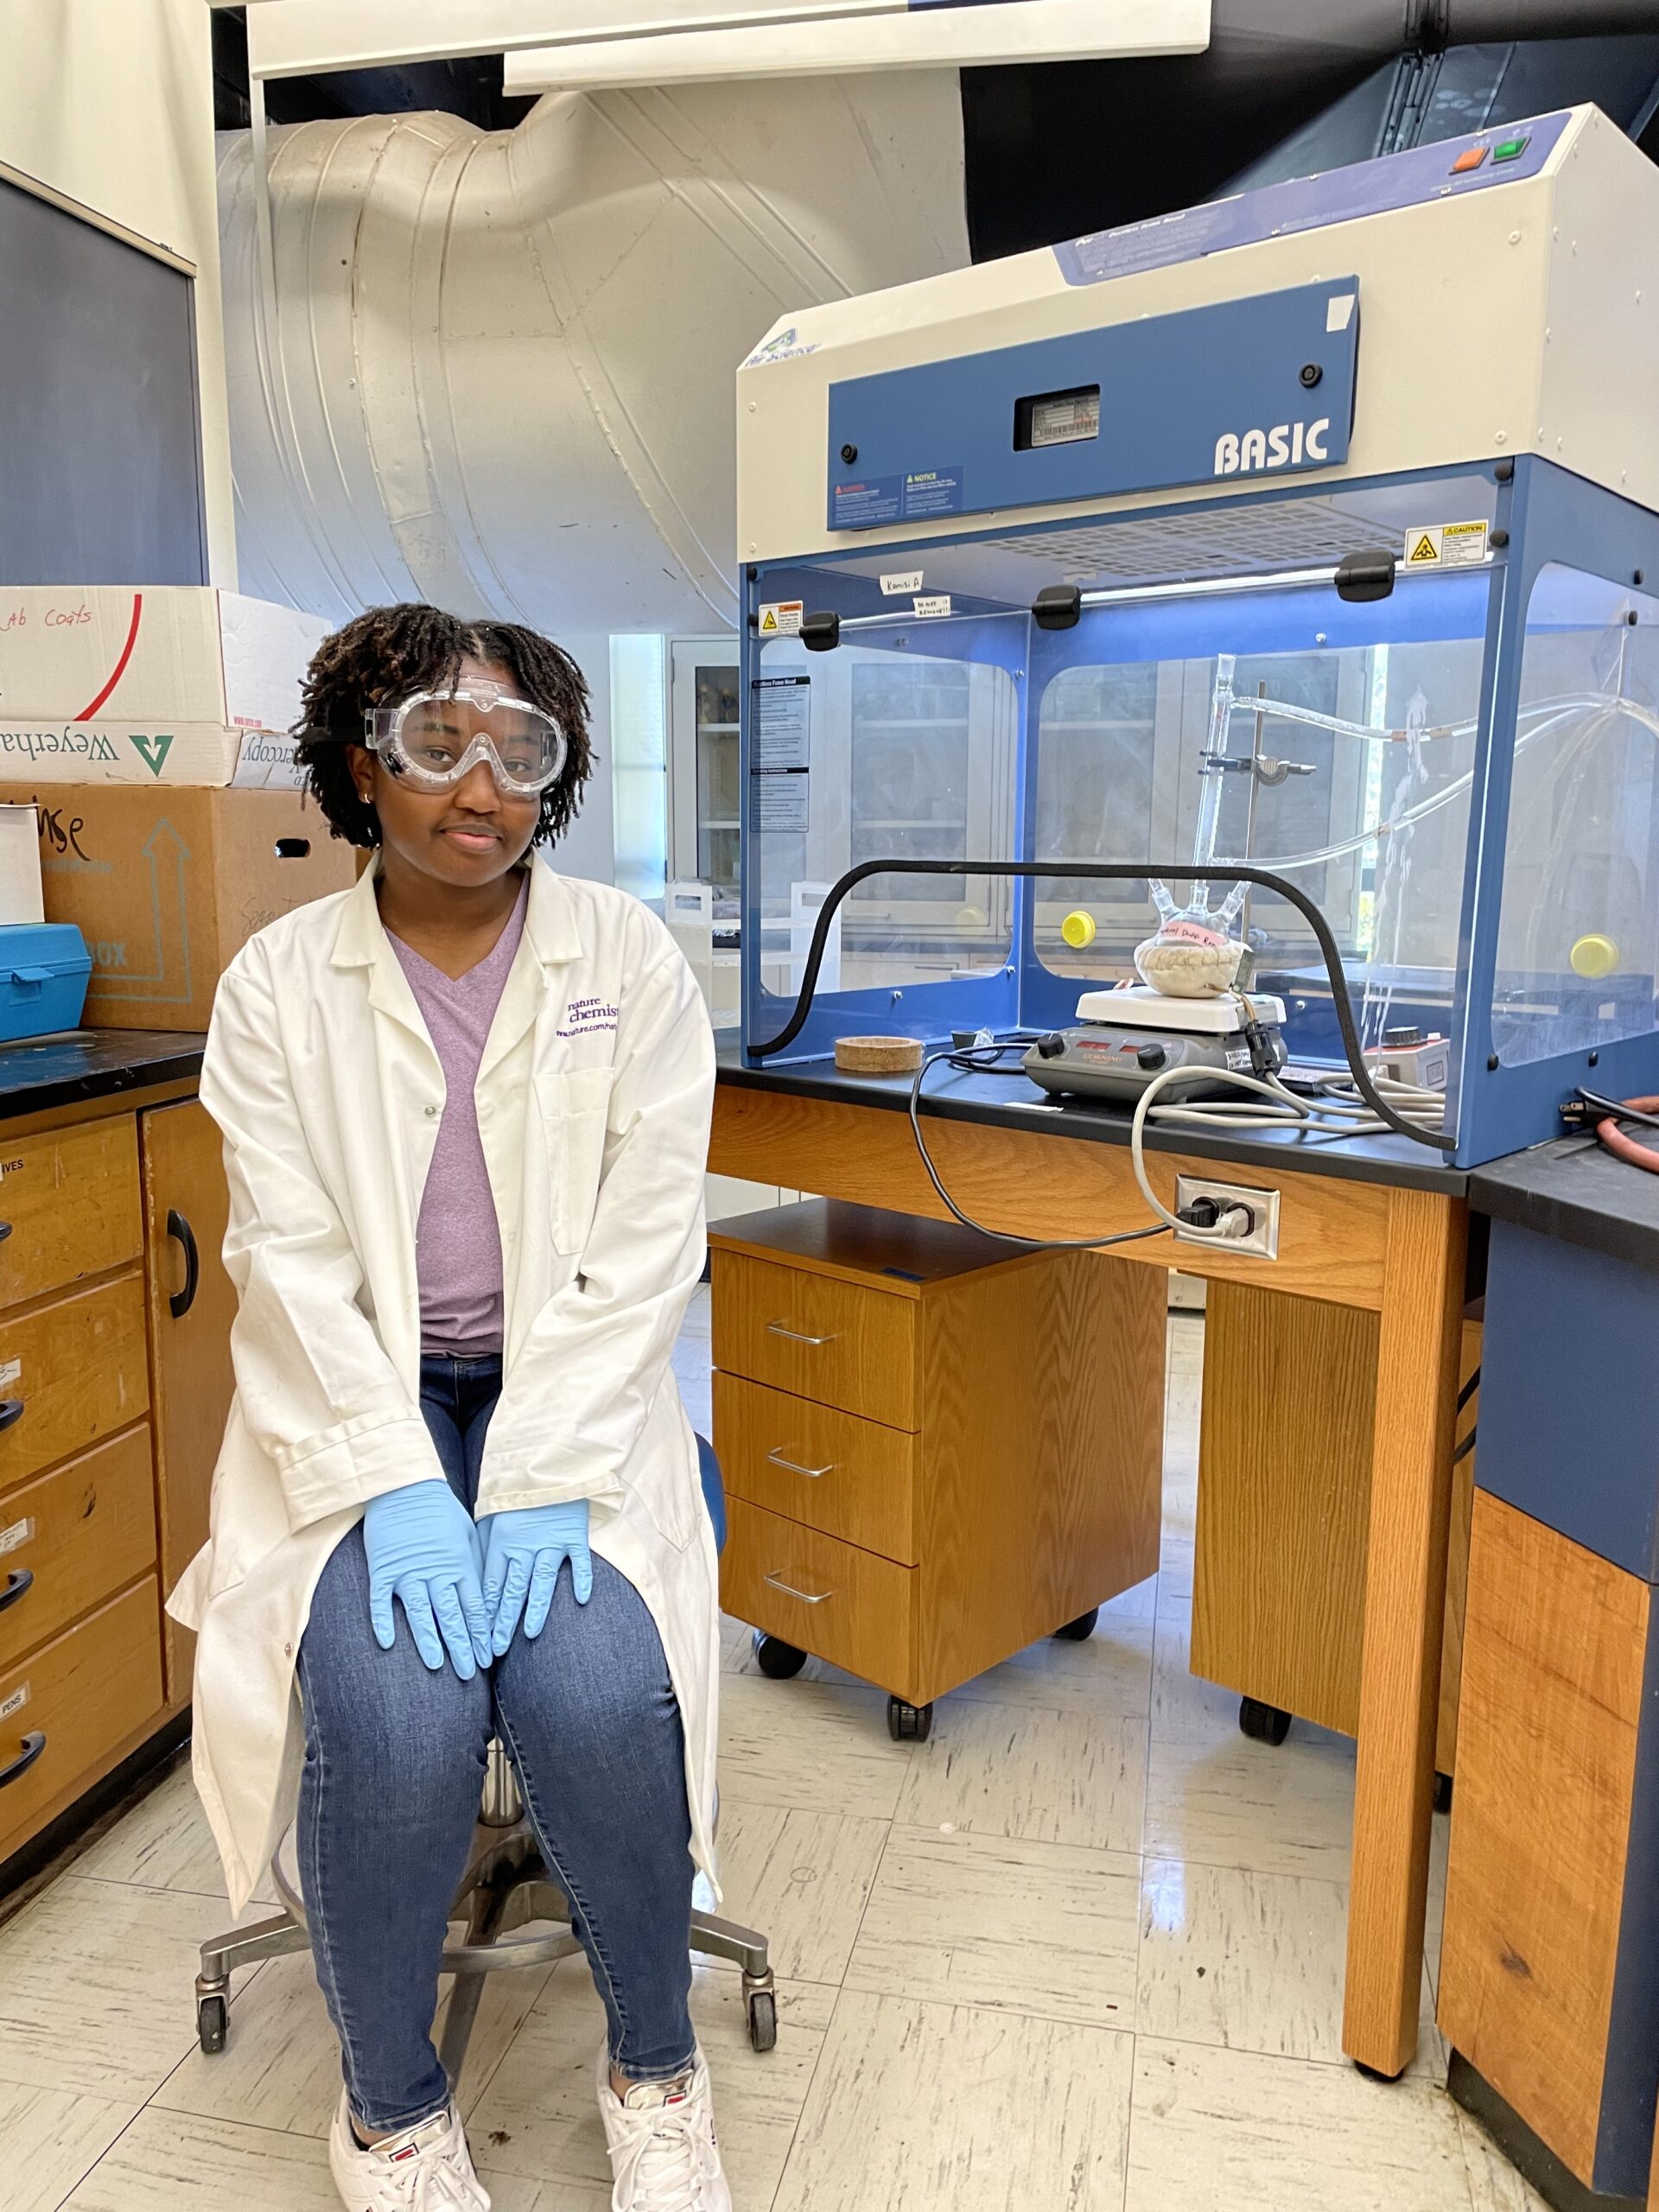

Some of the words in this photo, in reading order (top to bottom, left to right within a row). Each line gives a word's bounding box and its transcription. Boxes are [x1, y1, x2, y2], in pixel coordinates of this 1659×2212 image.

[1214, 417, 1330, 475] BASIC
[914, 473, 937, 482] NOTICE
[1453, 525, 1483, 534] CAUTION
[45, 604, 92, 626] Coats
[568, 998, 601, 1011] nature
[3, 1694, 22, 1714] PENS
